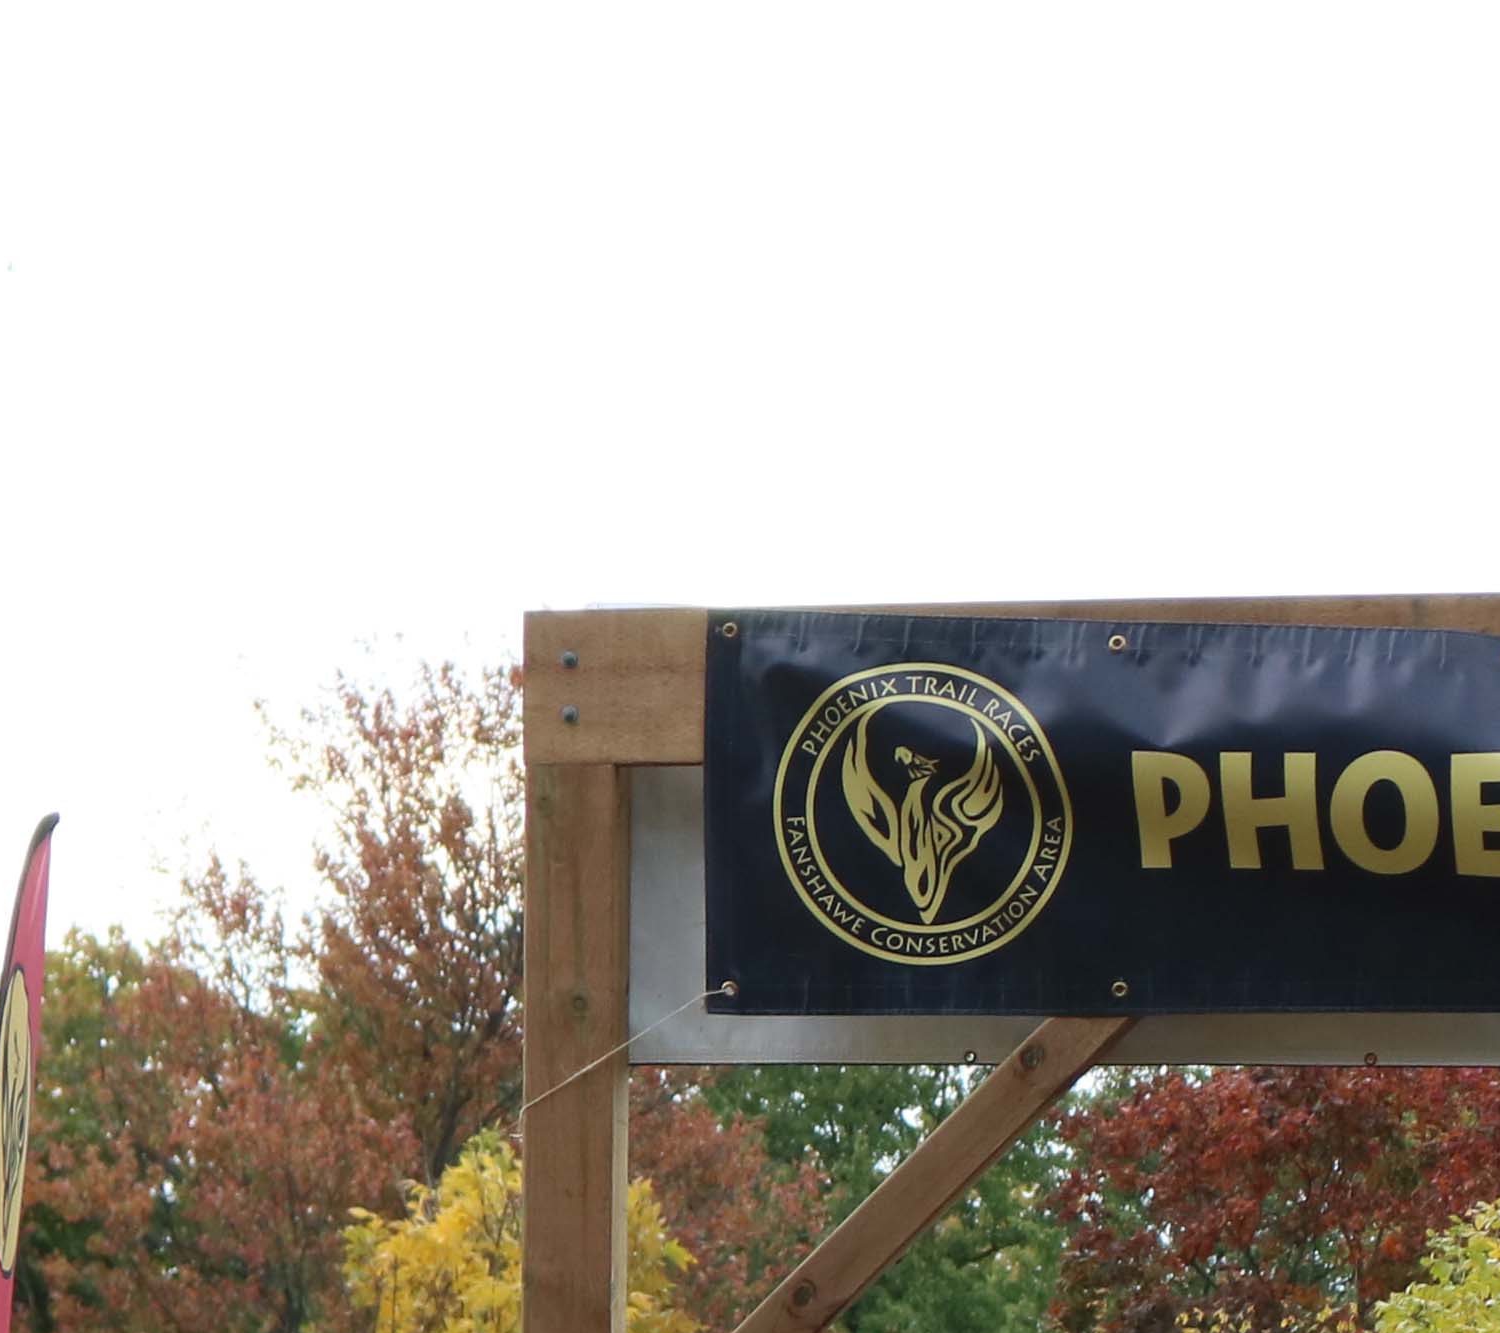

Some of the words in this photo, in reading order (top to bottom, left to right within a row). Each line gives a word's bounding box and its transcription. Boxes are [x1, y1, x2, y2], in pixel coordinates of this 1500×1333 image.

[802, 676, 898, 756] PHOENIX
[905, 675, 979, 708] TRAIL
[983, 698, 1041, 762] RACES
[786, 815, 866, 935] FANSHAWE
[870, 884, 1039, 955] CONSERVATION
[1032, 815, 1063, 882] AREA
